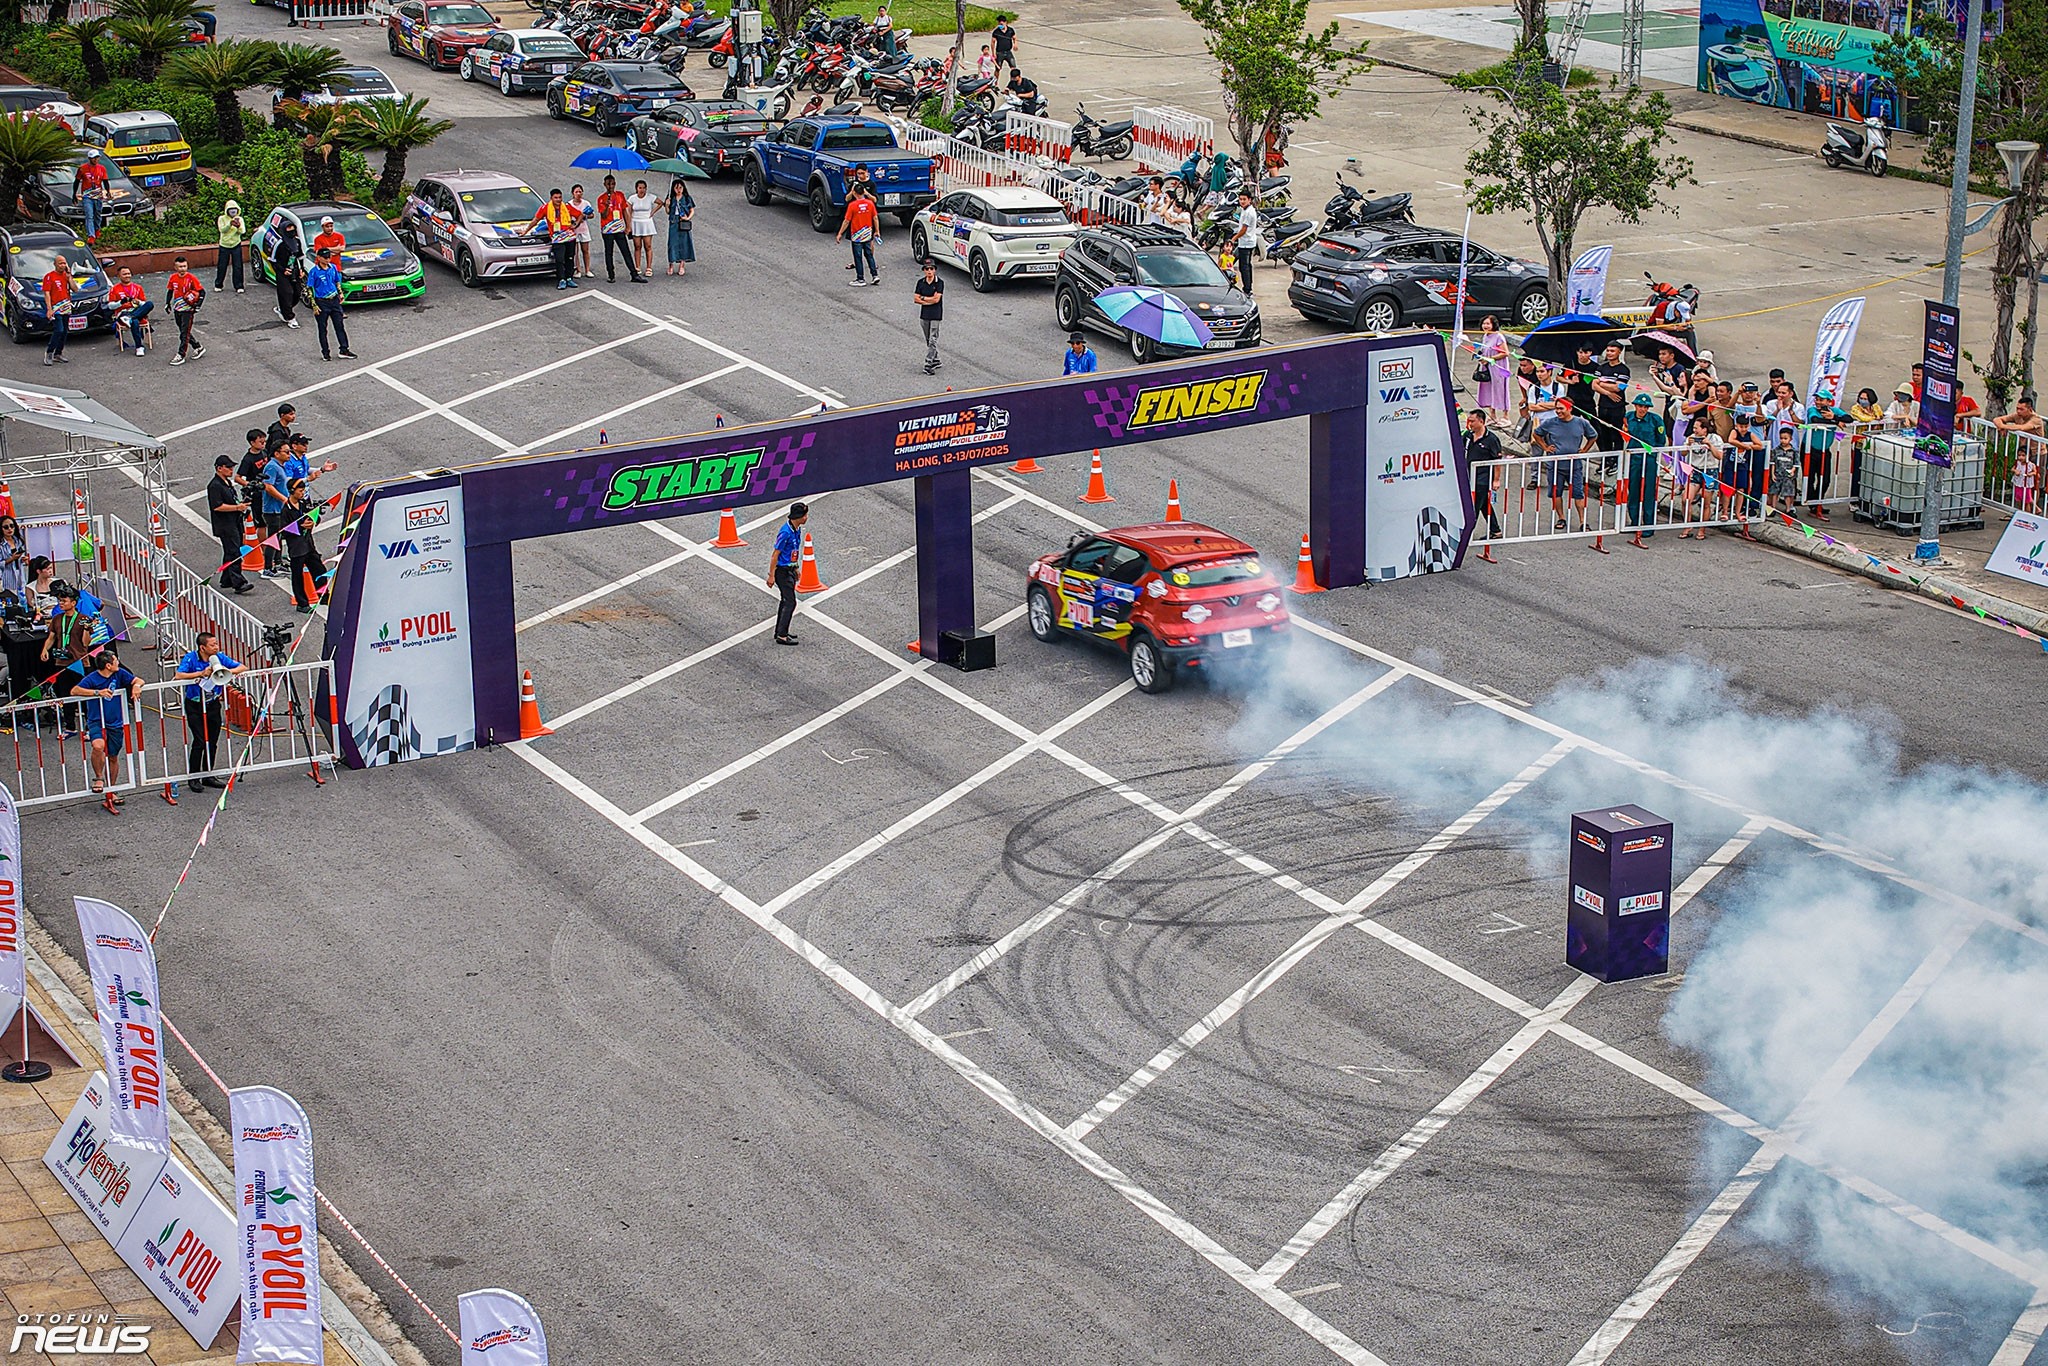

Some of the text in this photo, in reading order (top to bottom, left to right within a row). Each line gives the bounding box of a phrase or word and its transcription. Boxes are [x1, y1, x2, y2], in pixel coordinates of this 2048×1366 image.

[1777, 19, 1848, 51] Festival
[1381, 361, 1411, 373] OTV
[1381, 370, 1411, 379] MEDIA
[1131, 374, 1263, 425] FINISH
[895, 422, 976, 446] GYMKHANA
[898, 412, 958, 432] VIETNAM
[893, 440, 950, 455] CHAMPIONSHIP
[989, 431, 1005, 440] 2025
[895, 444, 1010, 472] HẠ LONG, 12-13/07/2025
[1401, 450, 1445, 474] PVOIL
[607, 452, 760, 507] START
[408, 505, 446, 520] OTV
[409, 515, 448, 528] MEDIA
[400, 611, 457, 641] PVOIL
[1585, 891, 1602, 909] PVOIL
[1635, 893, 1659, 907] PVOIL
[107, 985, 118, 1005] PVOIL
[113, 973, 130, 1019] PETROVIETNAM
[118, 1055, 125, 1066] xa
[126, 1022, 160, 1110] PVOIL
[119, 1068, 129, 1091] thêm
[65, 1115, 132, 1209] Ekokemika
[244, 1183, 254, 1206] PVOIL
[254, 1169, 266, 1220] PETROVIETNAM
[142, 1253, 156, 1272] PVOIL
[167, 1228, 222, 1305] PVOIL
[248, 1260, 255, 1273] xa
[261, 1224, 307, 1318] PVOIL
